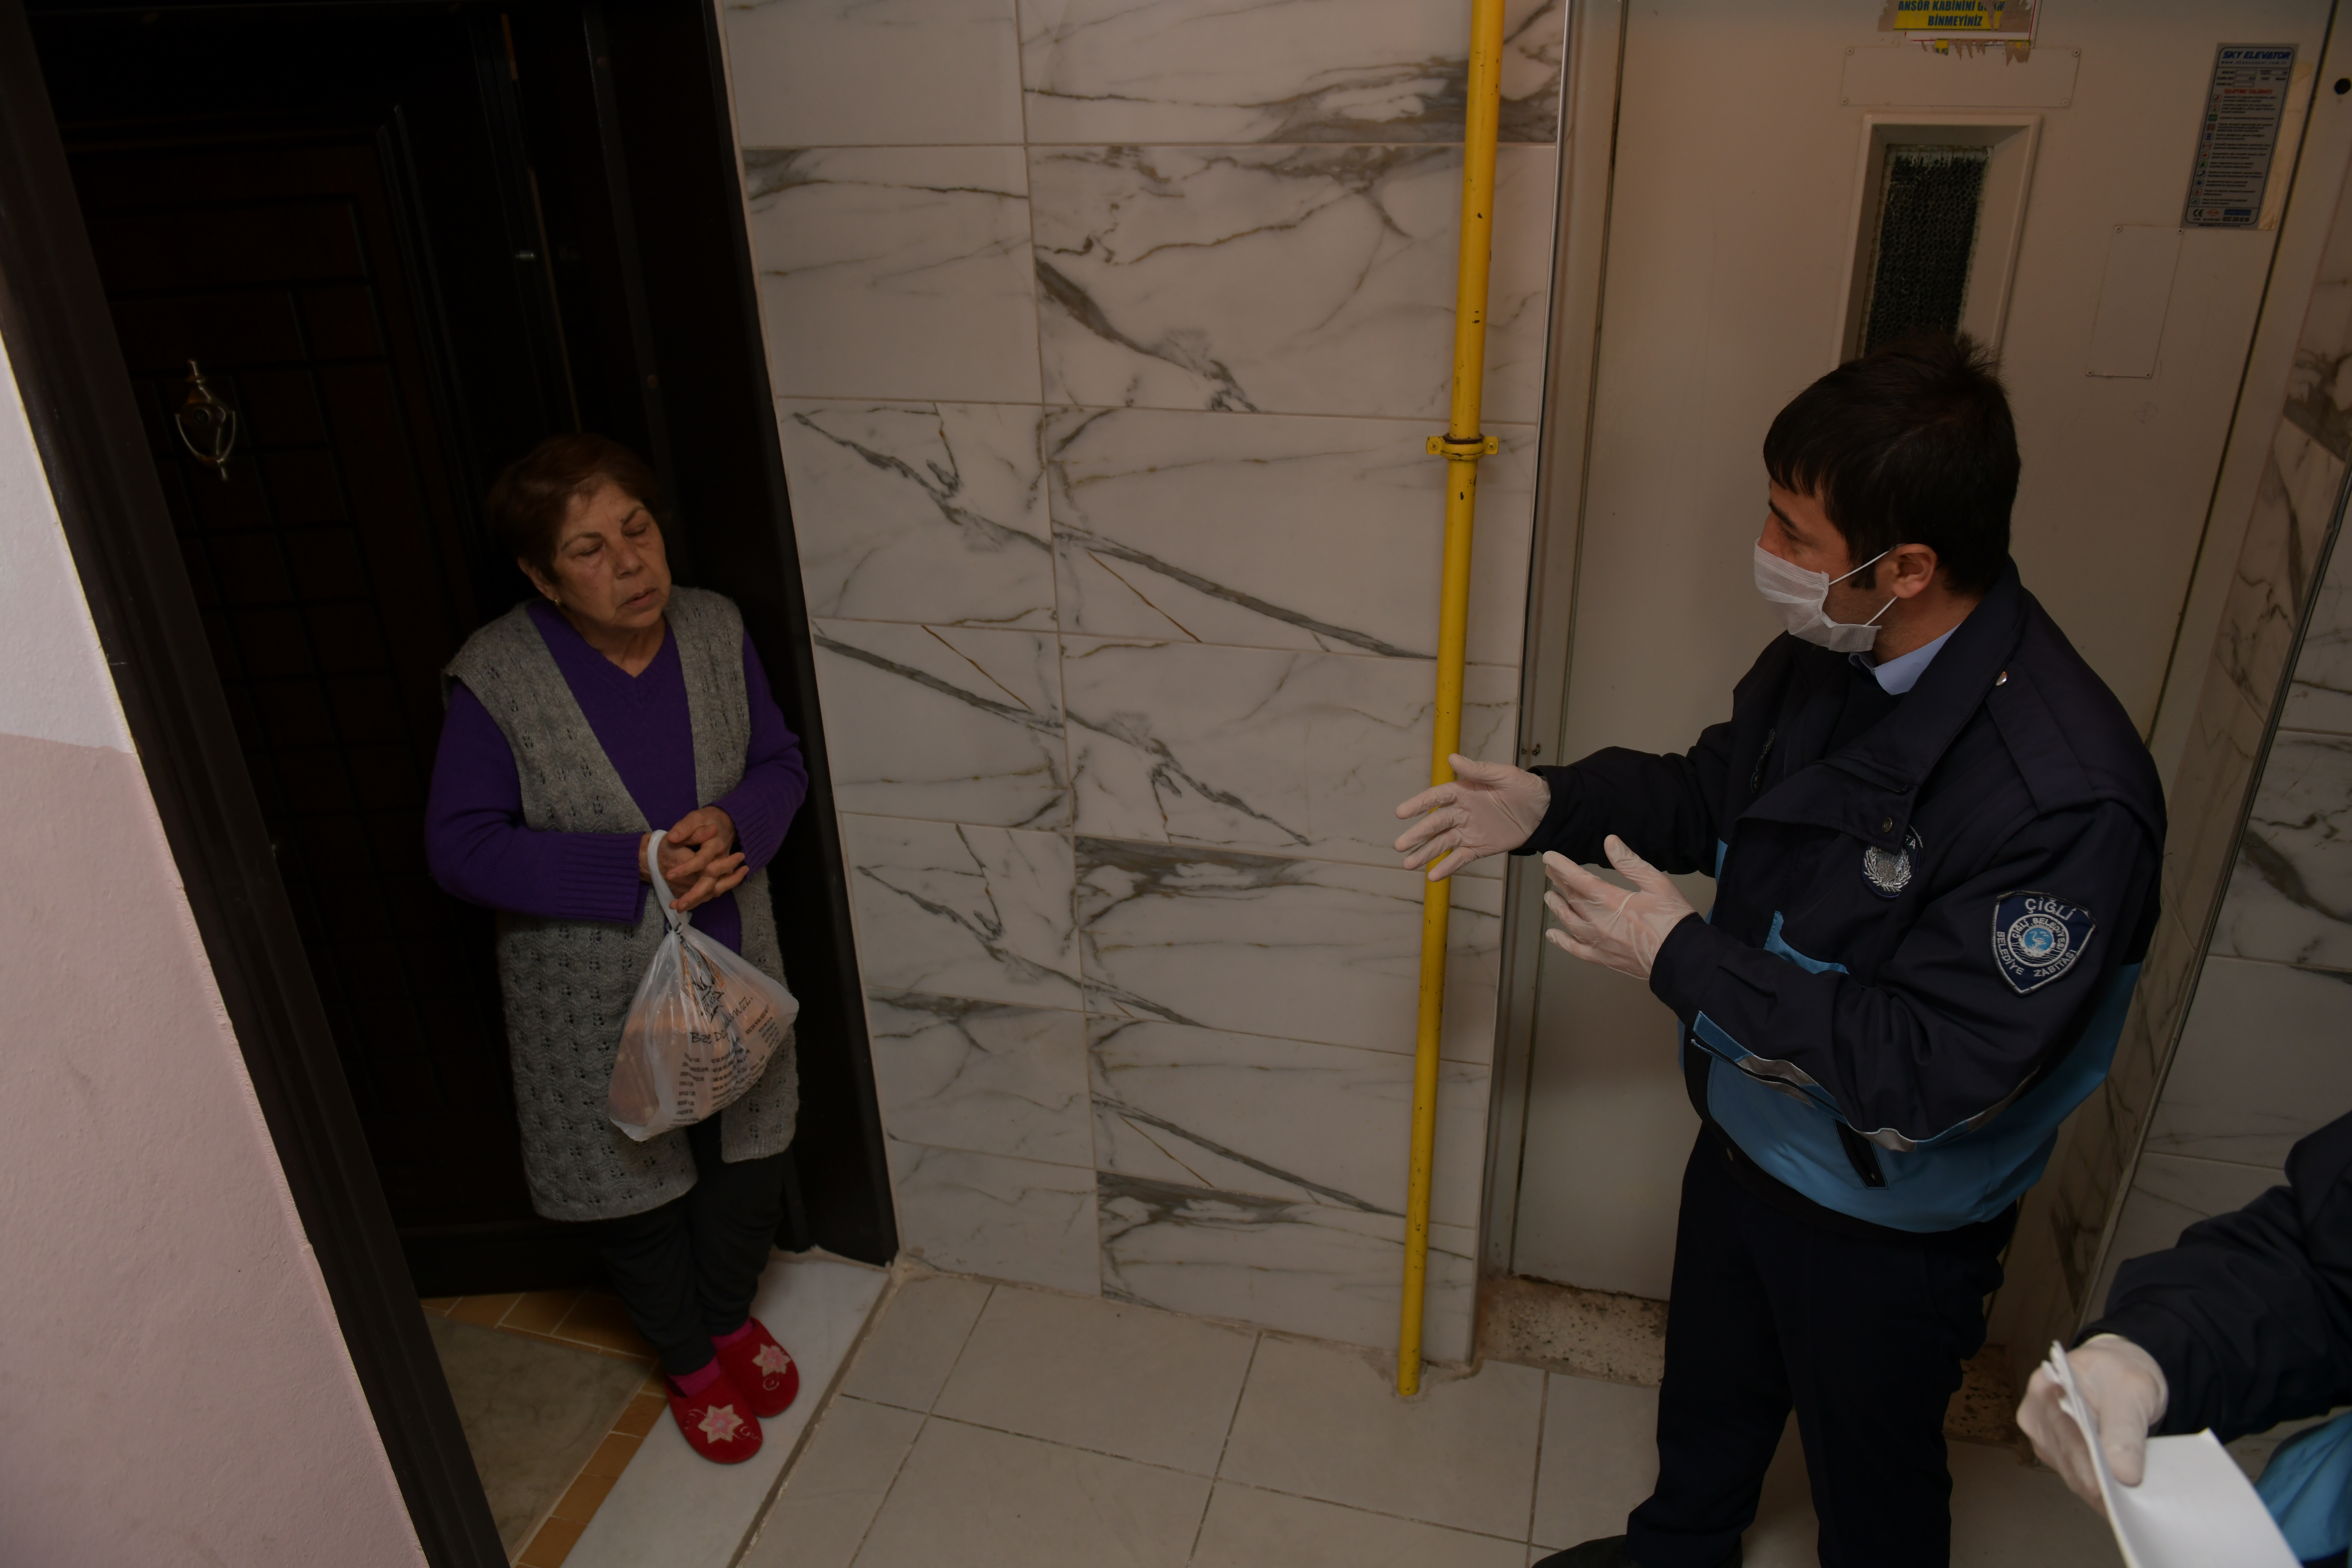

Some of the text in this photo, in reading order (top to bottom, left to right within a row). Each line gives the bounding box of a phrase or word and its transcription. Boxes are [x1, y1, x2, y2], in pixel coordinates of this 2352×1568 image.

[1928, 14, 1983, 26] BİNMEYİNİZ
[2025, 897, 2077, 921] ÇİĞLİ
[2012, 917, 2065, 950] ÇİĞLİ BELEDİYESİ
[1996, 931, 2025, 975] BELEDİYE
